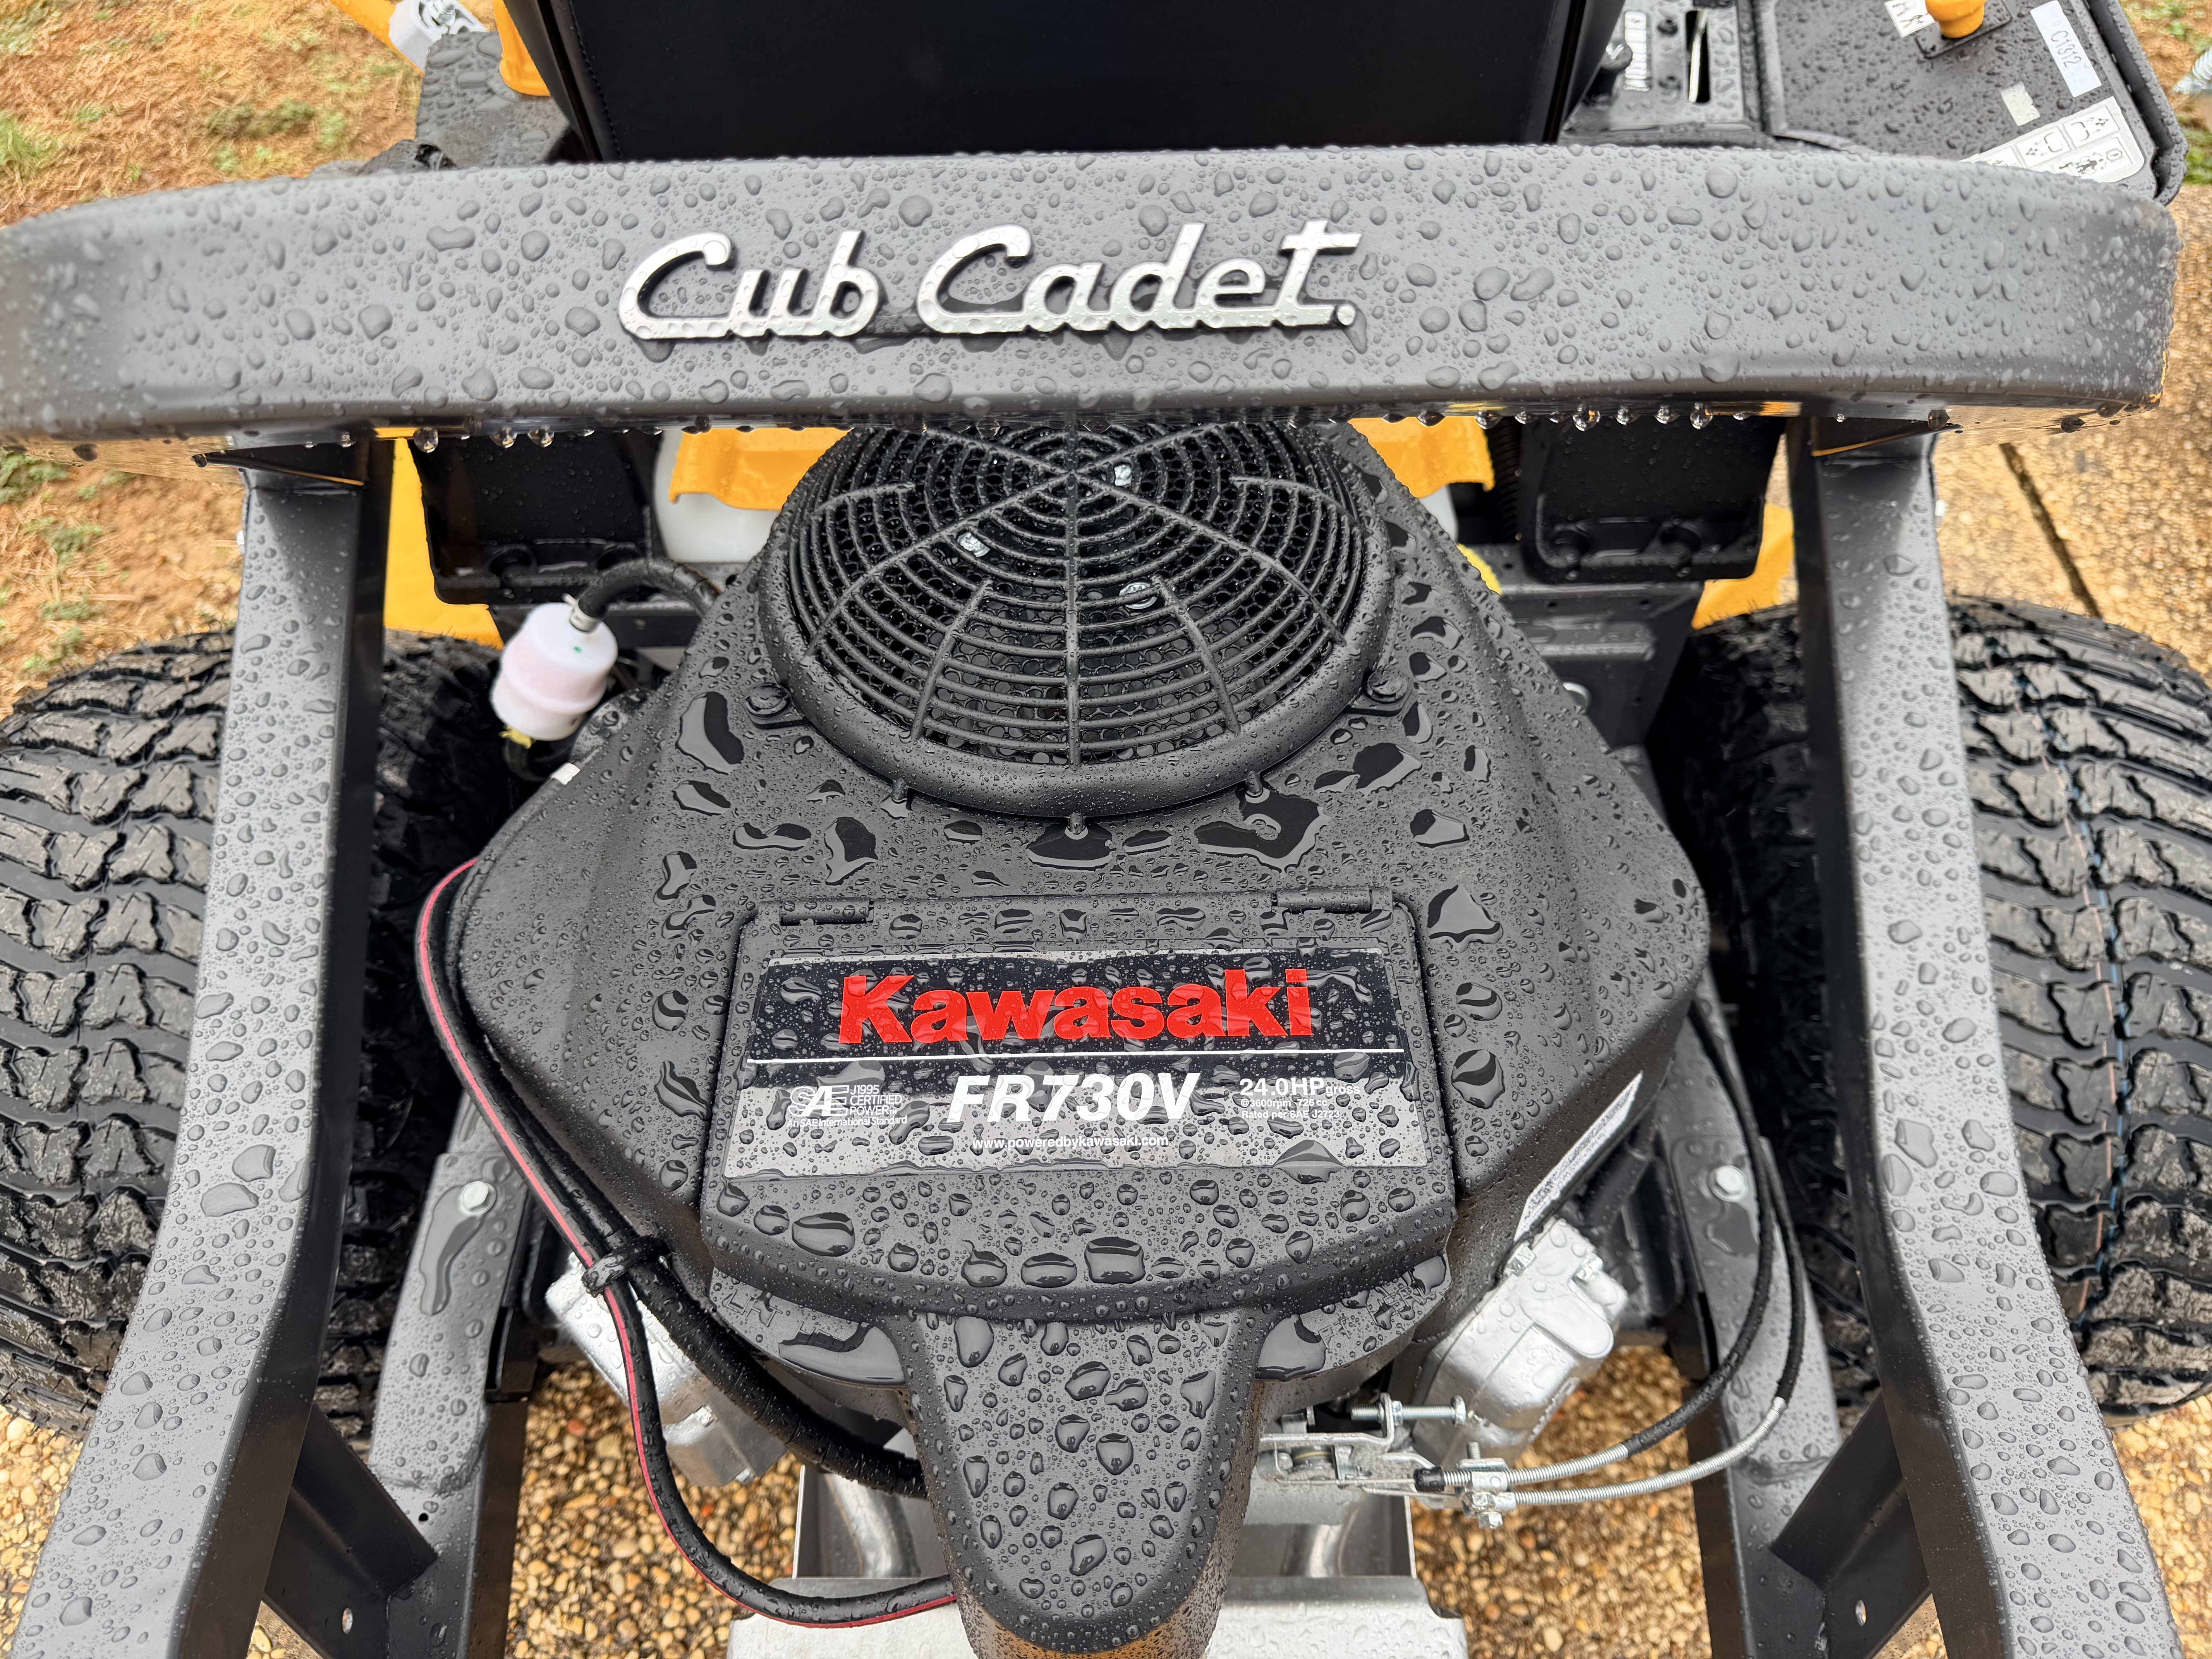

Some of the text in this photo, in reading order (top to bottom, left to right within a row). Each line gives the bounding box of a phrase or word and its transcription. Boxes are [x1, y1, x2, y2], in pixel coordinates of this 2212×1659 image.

[2051, 30, 2082, 68] C1312
[618, 229, 878, 339] Cub
[838, 968, 1313, 1044] Kawasaki
[850, 1084, 880, 1095] J1995
[788, 1085, 850, 1117] SAE
[850, 1094, 903, 1105] CERTIFIED
[946, 1072, 1201, 1123] FR730V
[1240, 1098, 1291, 1109] @3600rpm
[1297, 1098, 1315, 1107] 726
[787, 1115, 908, 1128] An SAE International Standard
[1242, 1109, 1340, 1120] Rated per SAE J2723
[972, 1135, 1169, 1150] www.poweredbykawasaki.com
